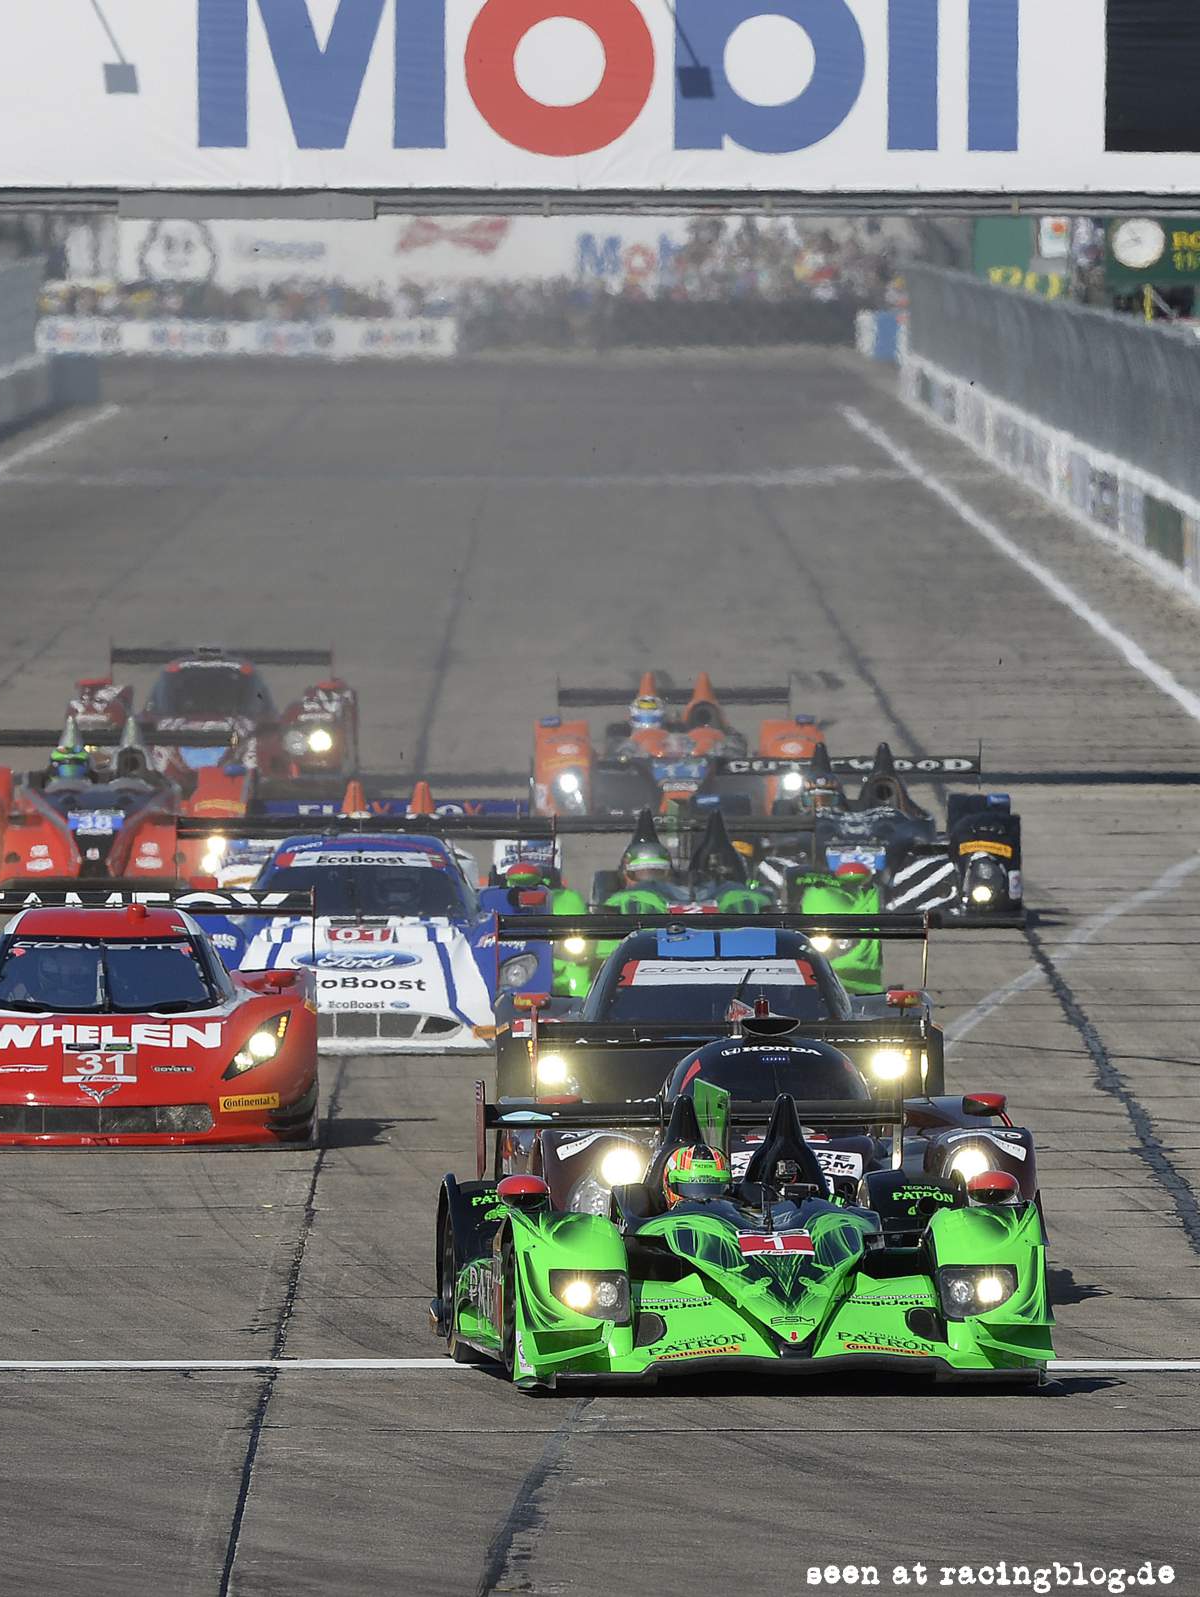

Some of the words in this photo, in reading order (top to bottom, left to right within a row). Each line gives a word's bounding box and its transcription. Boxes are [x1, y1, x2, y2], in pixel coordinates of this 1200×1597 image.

[76, 813, 113, 829] 38
[316, 855, 407, 865] EcoBoost
[316, 953, 398, 970] Ford
[328, 1001, 385, 1010] EcoBoost
[741, 1045, 822, 1057] HONDA
[75, 1053, 124, 1075] 31
[153, 1065, 194, 1073] COYOTE
[223, 1096, 270, 1110] Continental
[764, 1235, 785, 1250] 1
[770, 1316, 815, 1326] ESM
